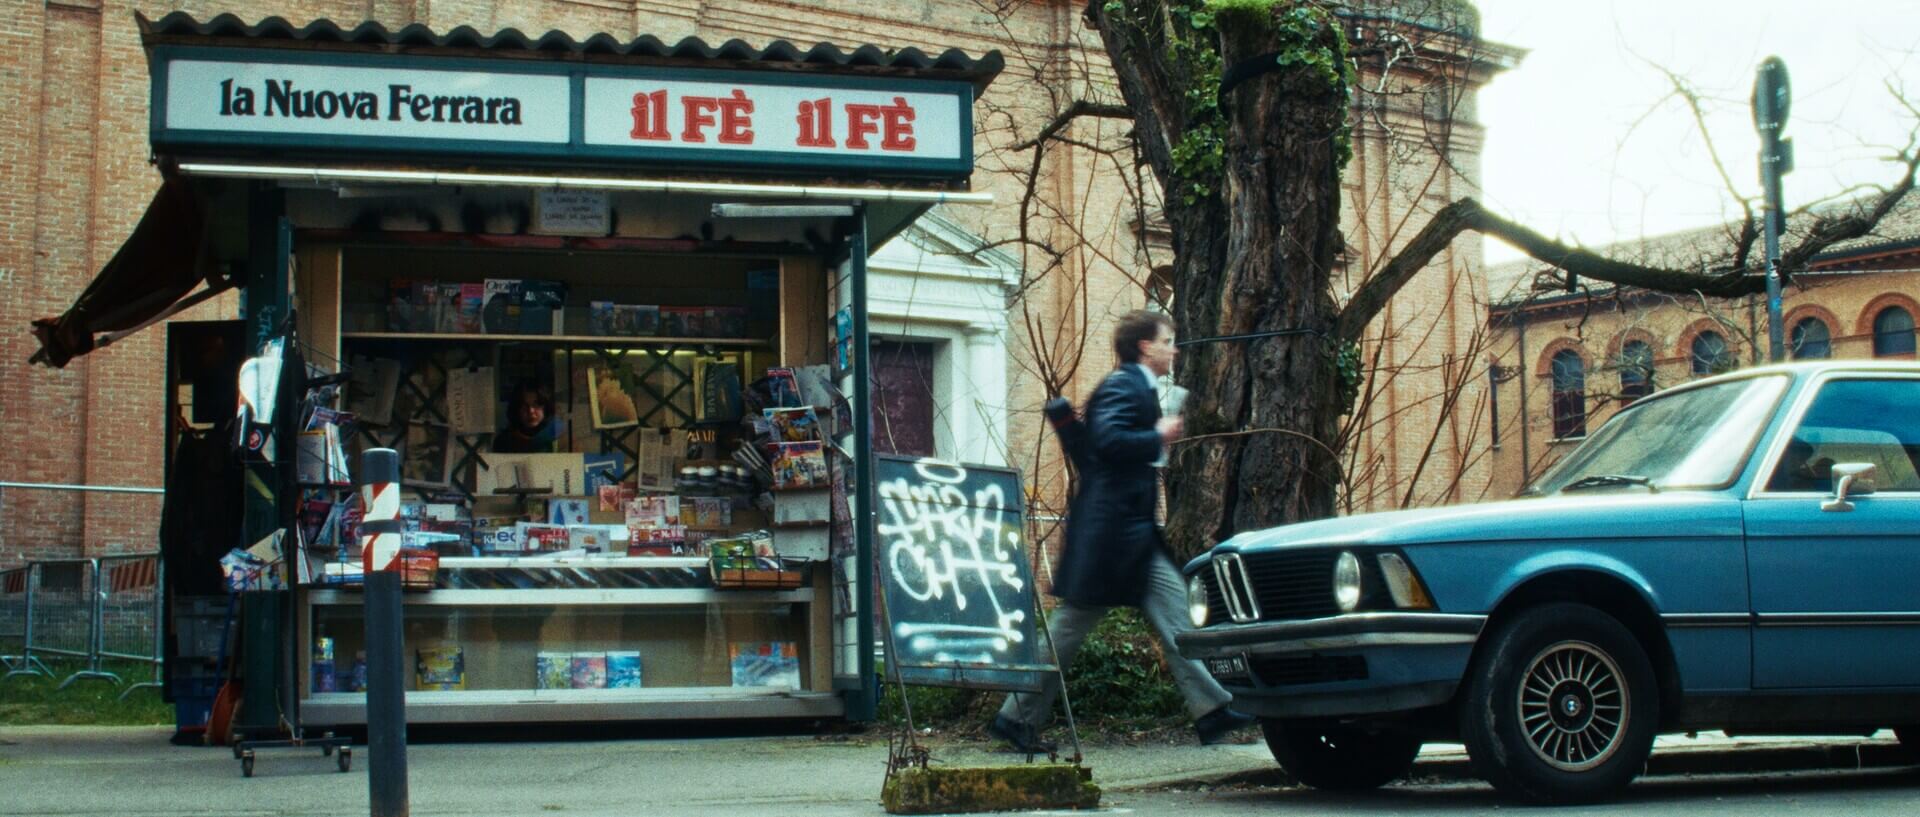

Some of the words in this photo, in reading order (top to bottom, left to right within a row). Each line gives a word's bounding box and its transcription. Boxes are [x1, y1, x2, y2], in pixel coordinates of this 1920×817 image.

[220, 78, 256, 116] la
[264, 79, 379, 120] Nuova
[387, 84, 522, 125] Ferrara
[630, 89, 672, 141] il
[681, 89, 755, 145] FÈ
[796, 97, 836, 148] il
[845, 97, 916, 152] FÈ
